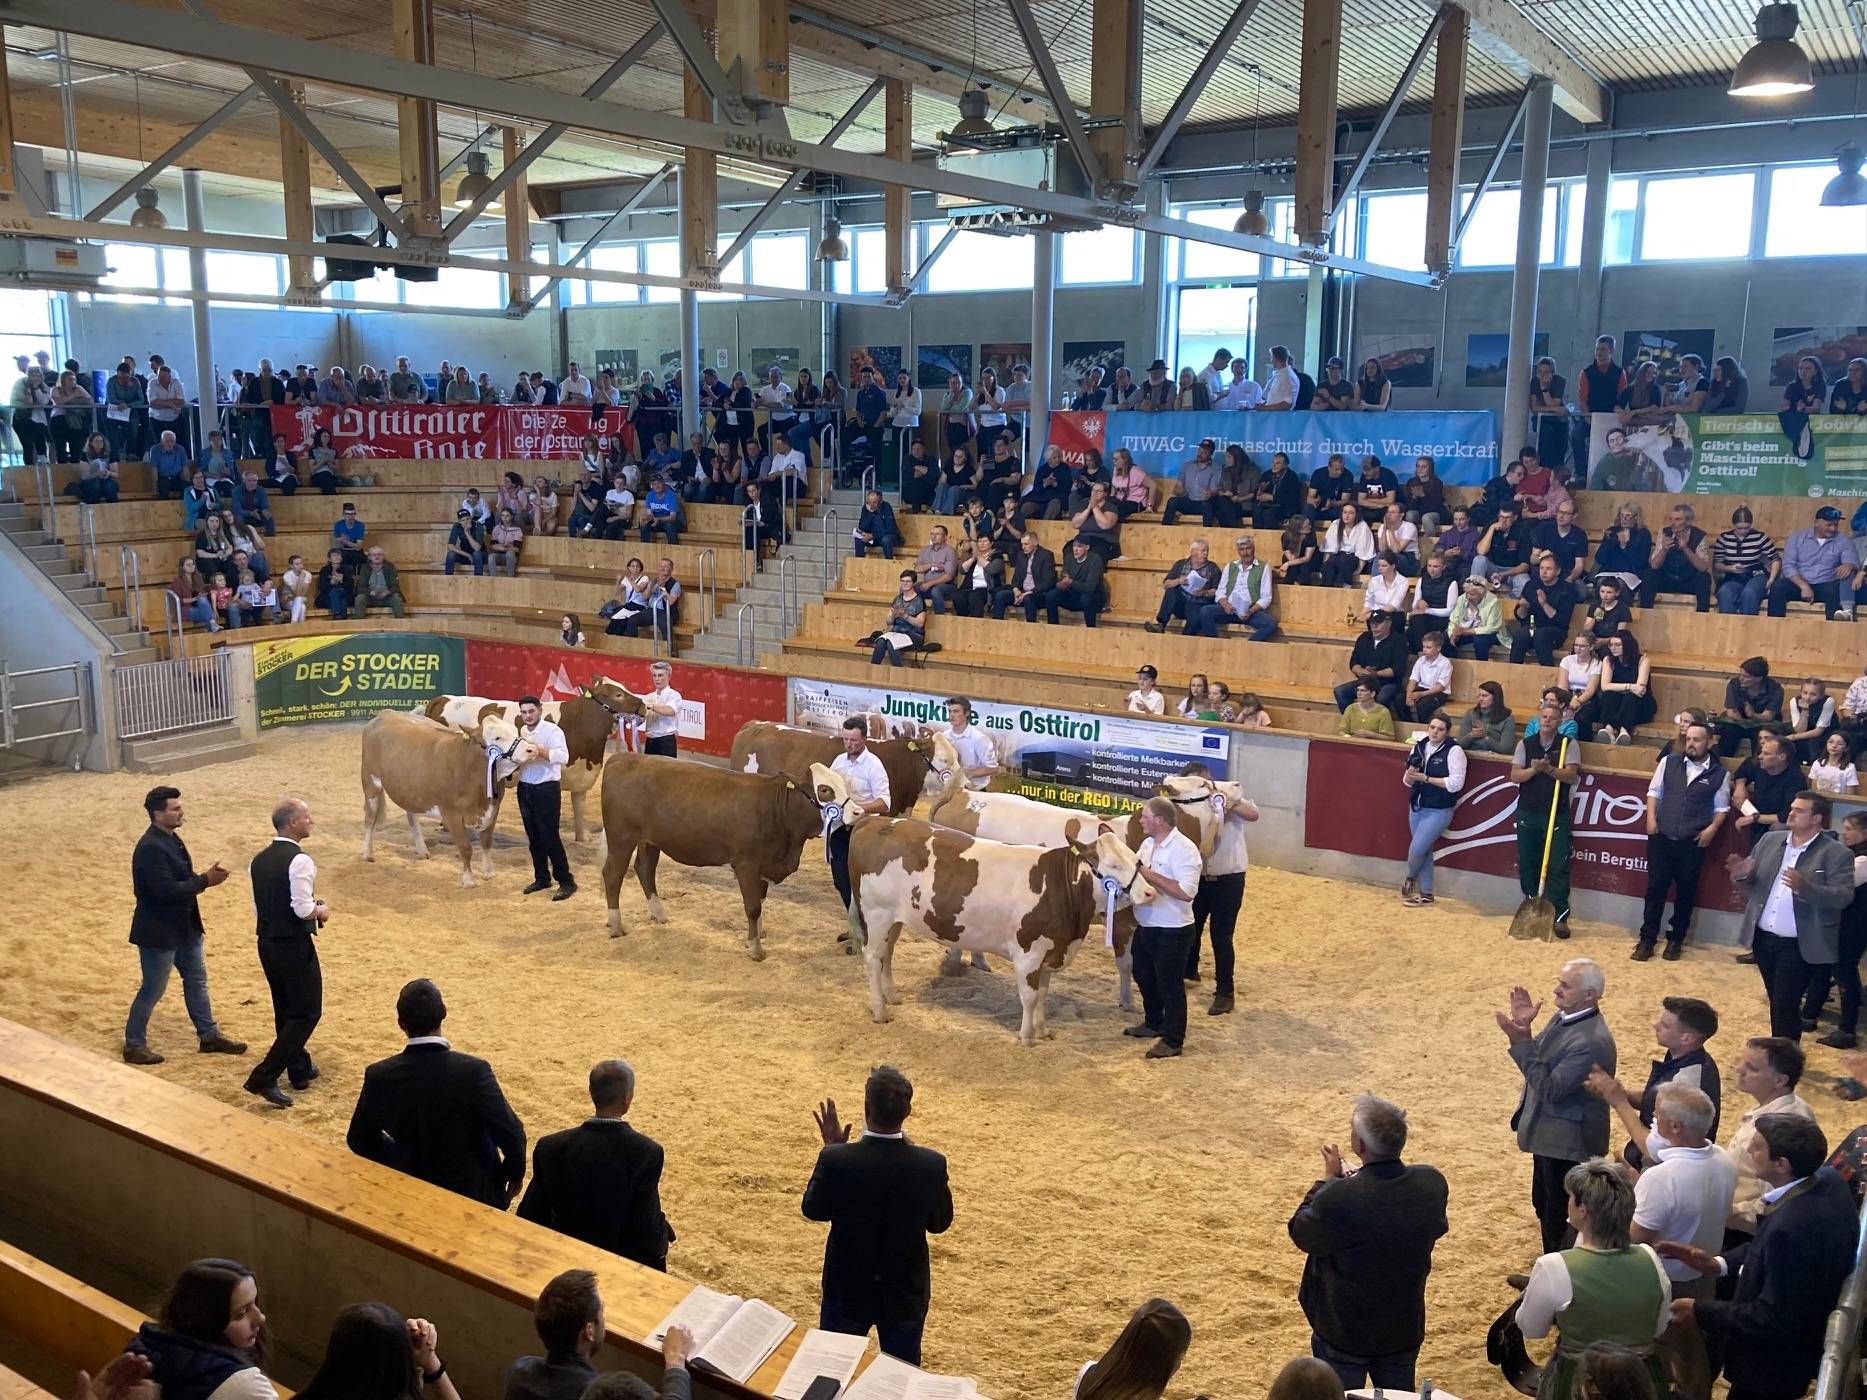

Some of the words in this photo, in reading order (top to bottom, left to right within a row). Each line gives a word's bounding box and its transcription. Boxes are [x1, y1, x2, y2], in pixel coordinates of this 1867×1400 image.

[522, 414, 546, 429] Die
[551, 415, 608, 432] Zeng
[1704, 419, 1762, 432] Tierisch
[514, 434, 541, 449] der
[1122, 436, 1185, 453] TIWAG
[1203, 436, 1313, 454] limaschutz
[1318, 438, 1375, 456] durch
[1380, 439, 1499, 459] Wasserkraft
[1702, 440, 1741, 451] Gibt's
[1743, 441, 1779, 452] beim
[1061, 450, 1086, 466] WA
[1700, 452, 1808, 468] Maschinenring
[1699, 465, 1758, 477] Osttirol!
[256, 652, 294, 676] STOCKER
[295, 661, 338, 681] DER
[341, 653, 440, 672] STOCKER
[356, 673, 436, 690] STADEL
[339, 700, 357, 708] DER
[358, 699, 412, 707] INDIVIDUELLE
[307, 710, 346, 720] STOCKER
[350, 709, 367, 717] 9911
[681, 707, 703, 725] TIROL
[880, 694, 980, 726] Jungküe
[985, 714, 1014, 730] aus
[1019, 709, 1100, 742] Osttirol
[1091, 748, 1140, 763] kontrollierte
[1092, 761, 1140, 775] kontrollierte
[1092, 773, 1140, 788] kontrollierte
[1044, 786, 1056, 800] in
[1059, 788, 1081, 804] der
[1083, 790, 1111, 808] RGO
[1121, 797, 1144, 812] Are
